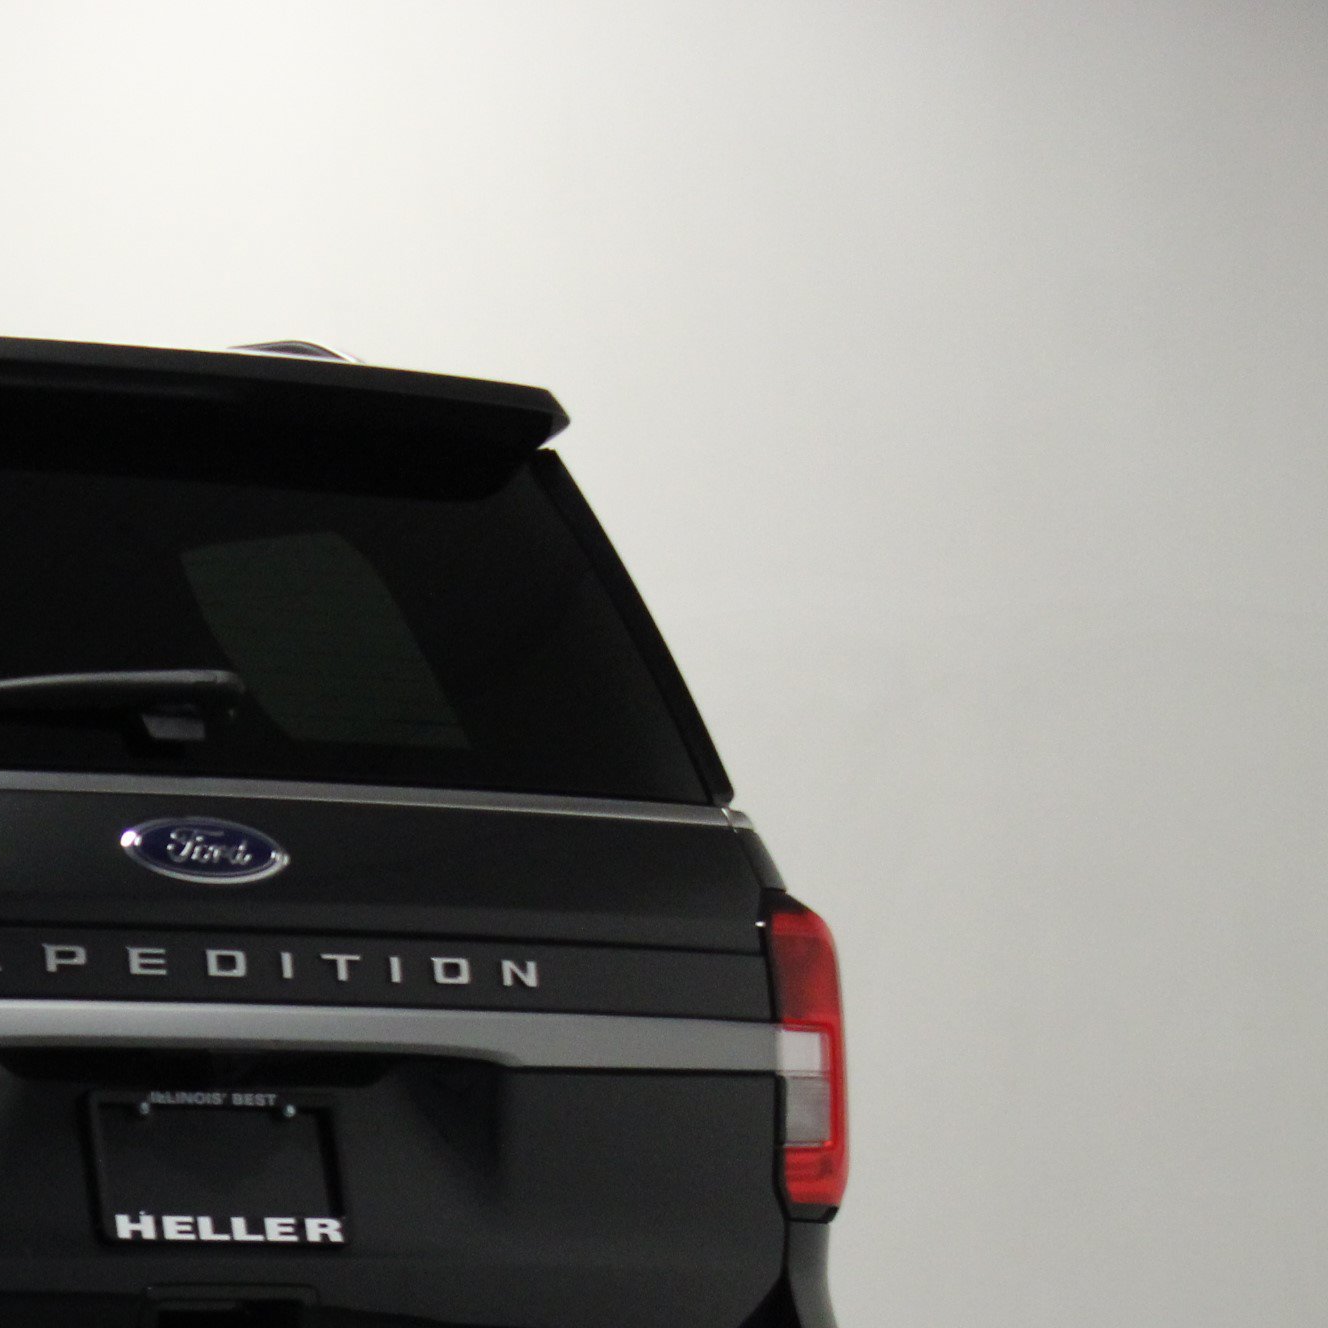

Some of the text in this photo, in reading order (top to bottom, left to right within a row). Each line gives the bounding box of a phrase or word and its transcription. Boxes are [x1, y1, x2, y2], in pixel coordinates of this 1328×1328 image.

[166, 826, 253, 866] Ford
[231, 1091, 278, 1108] BEST
[114, 1211, 345, 1244] HELLER
